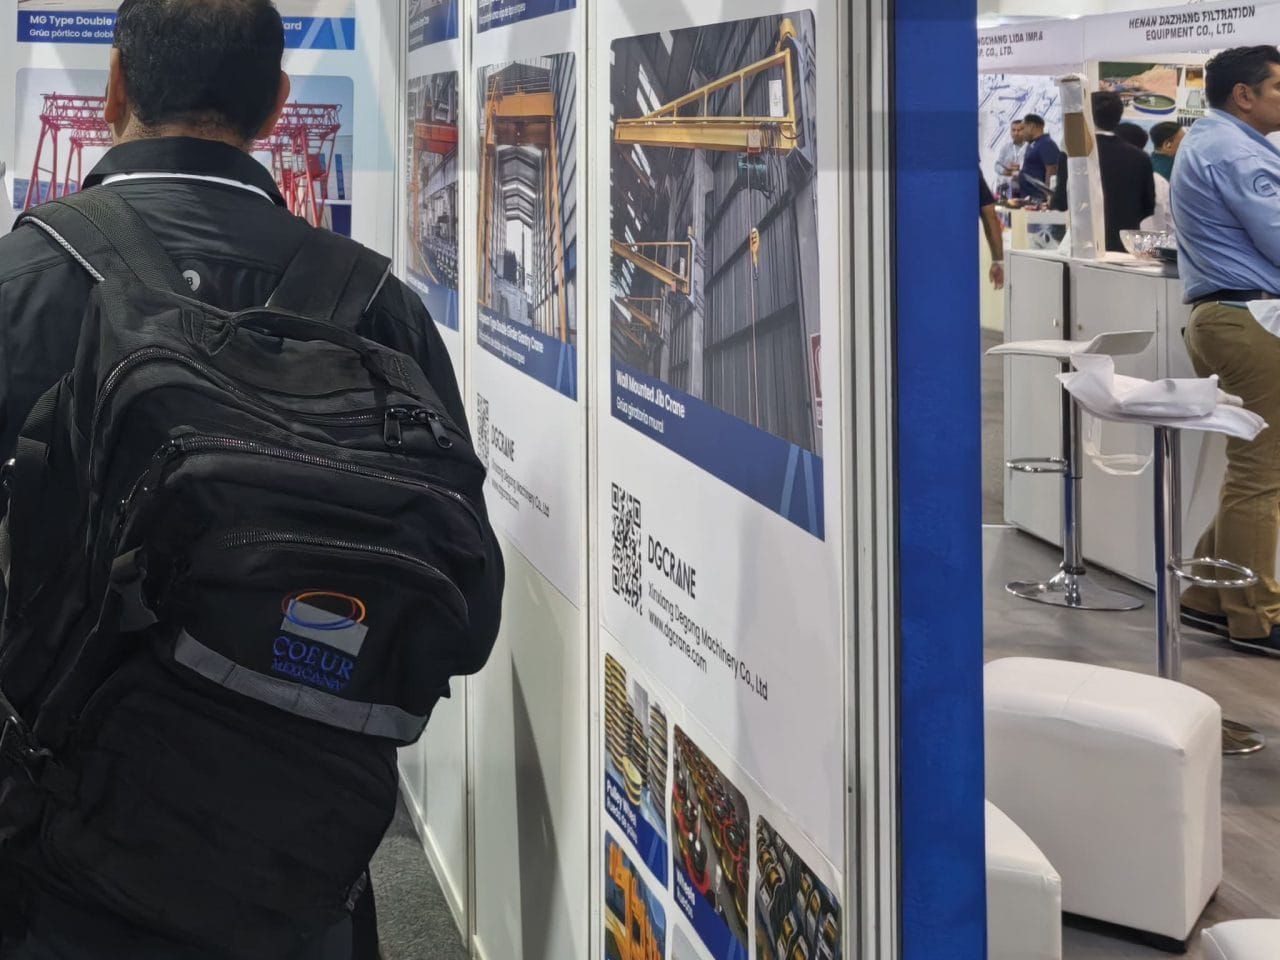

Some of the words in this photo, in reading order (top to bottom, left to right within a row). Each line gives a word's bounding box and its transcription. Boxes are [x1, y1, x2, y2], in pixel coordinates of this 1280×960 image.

[29, 27, 50, 38] Grúa
[51, 28, 80, 40] pórtico
[81, 29, 92, 38] de
[30, 15, 47, 25] MG
[49, 15, 74, 27] Type
[75, 16, 112, 26] Double
[1129, 16, 1158, 29] HENAN
[1159, 12, 1200, 26] DAZHANG
[1202, 5, 1256, 22] FILTRATION
[1146, 26, 1194, 41] EQUIPMENT
[1196, 24, 1213, 38] CO.,
[1216, 23, 1236, 35] LTD.
[628, 375, 654, 403] Mounted
[655, 388, 665, 408] Jib
[665, 393, 685, 418] Crane
[648, 534, 696, 600] DGCRANE
[273, 636, 354, 680] COEUR
[648, 607, 708, 673] www.dgcrane.com
[648, 581, 674, 622] Xinxiang
[675, 604, 700, 646] Degong
[701, 627, 738, 680] Machinery
[739, 661, 754, 692] Co.,
[755, 673, 768, 701] Ltd
